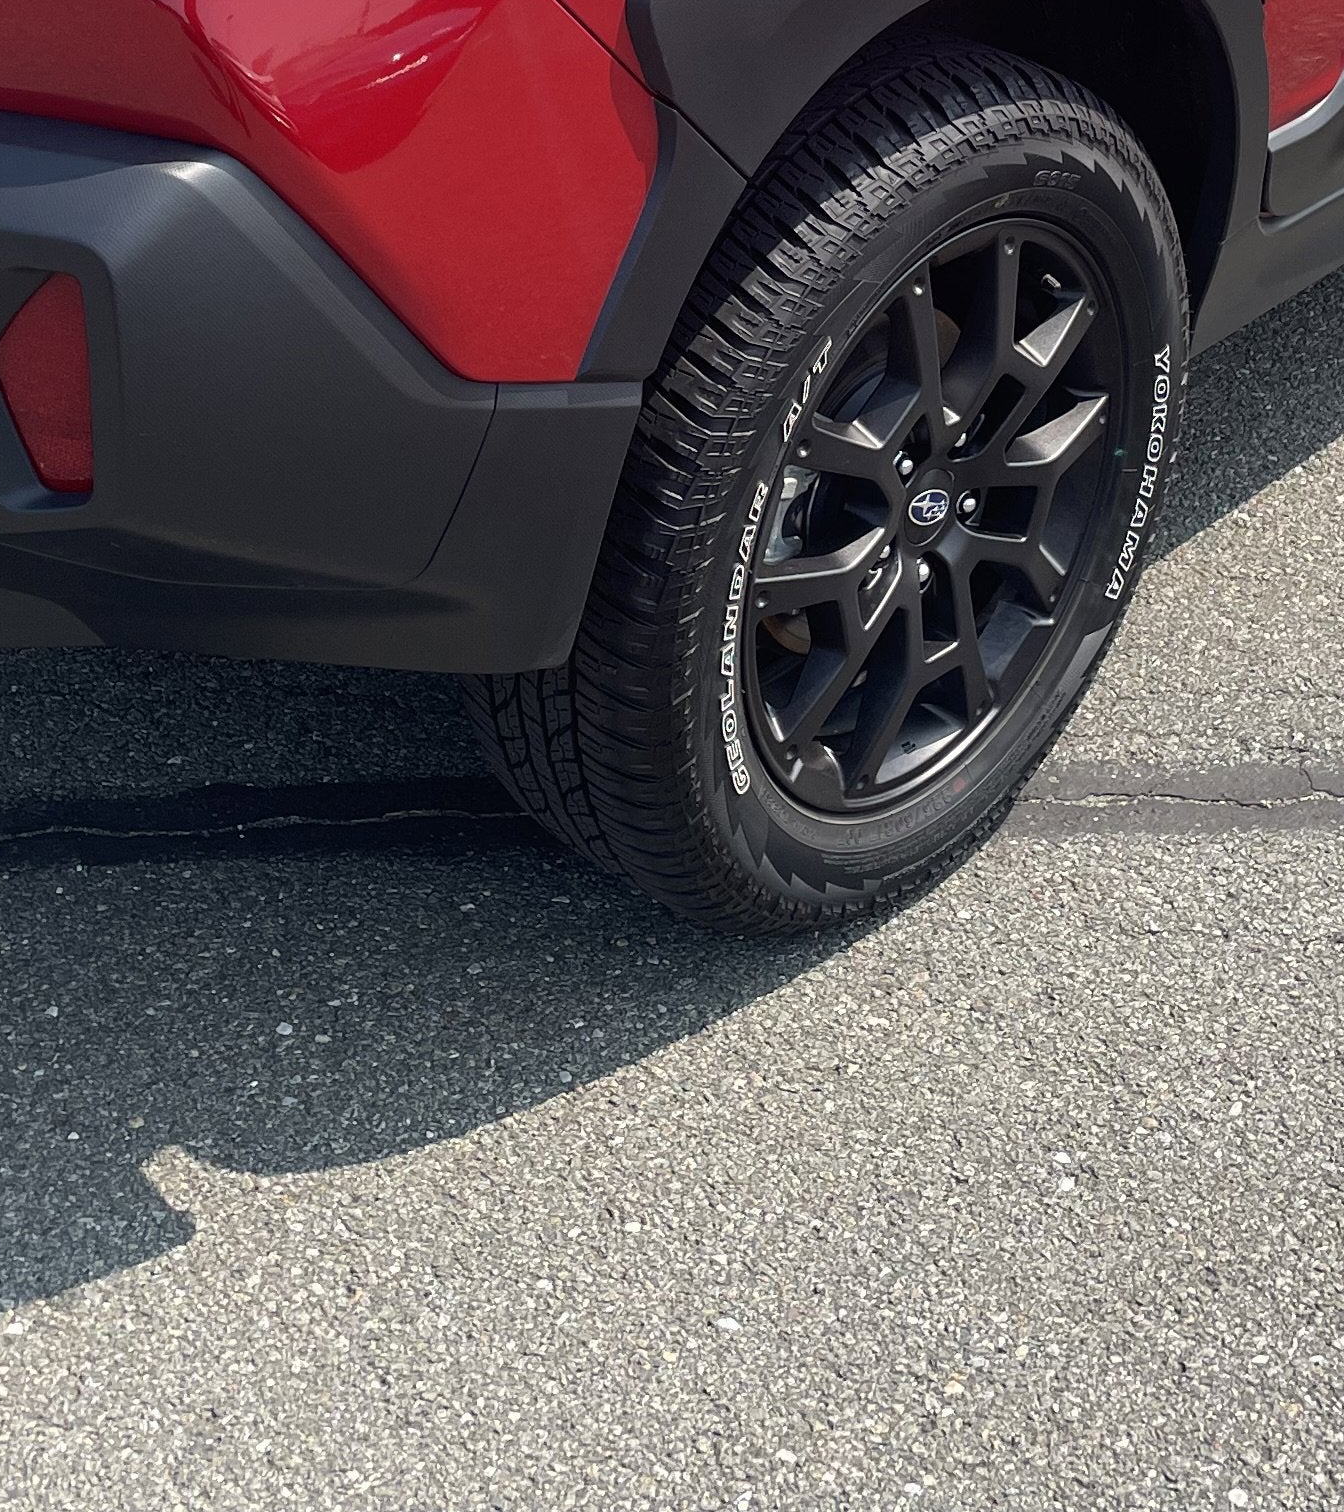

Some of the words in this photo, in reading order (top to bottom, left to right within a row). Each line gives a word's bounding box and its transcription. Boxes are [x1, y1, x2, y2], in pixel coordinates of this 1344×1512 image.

[720, 482, 769, 797] GEOLANDAR
[783, 335, 832, 443] A/T
[1105, 344, 1171, 599] YOKOHAMA
